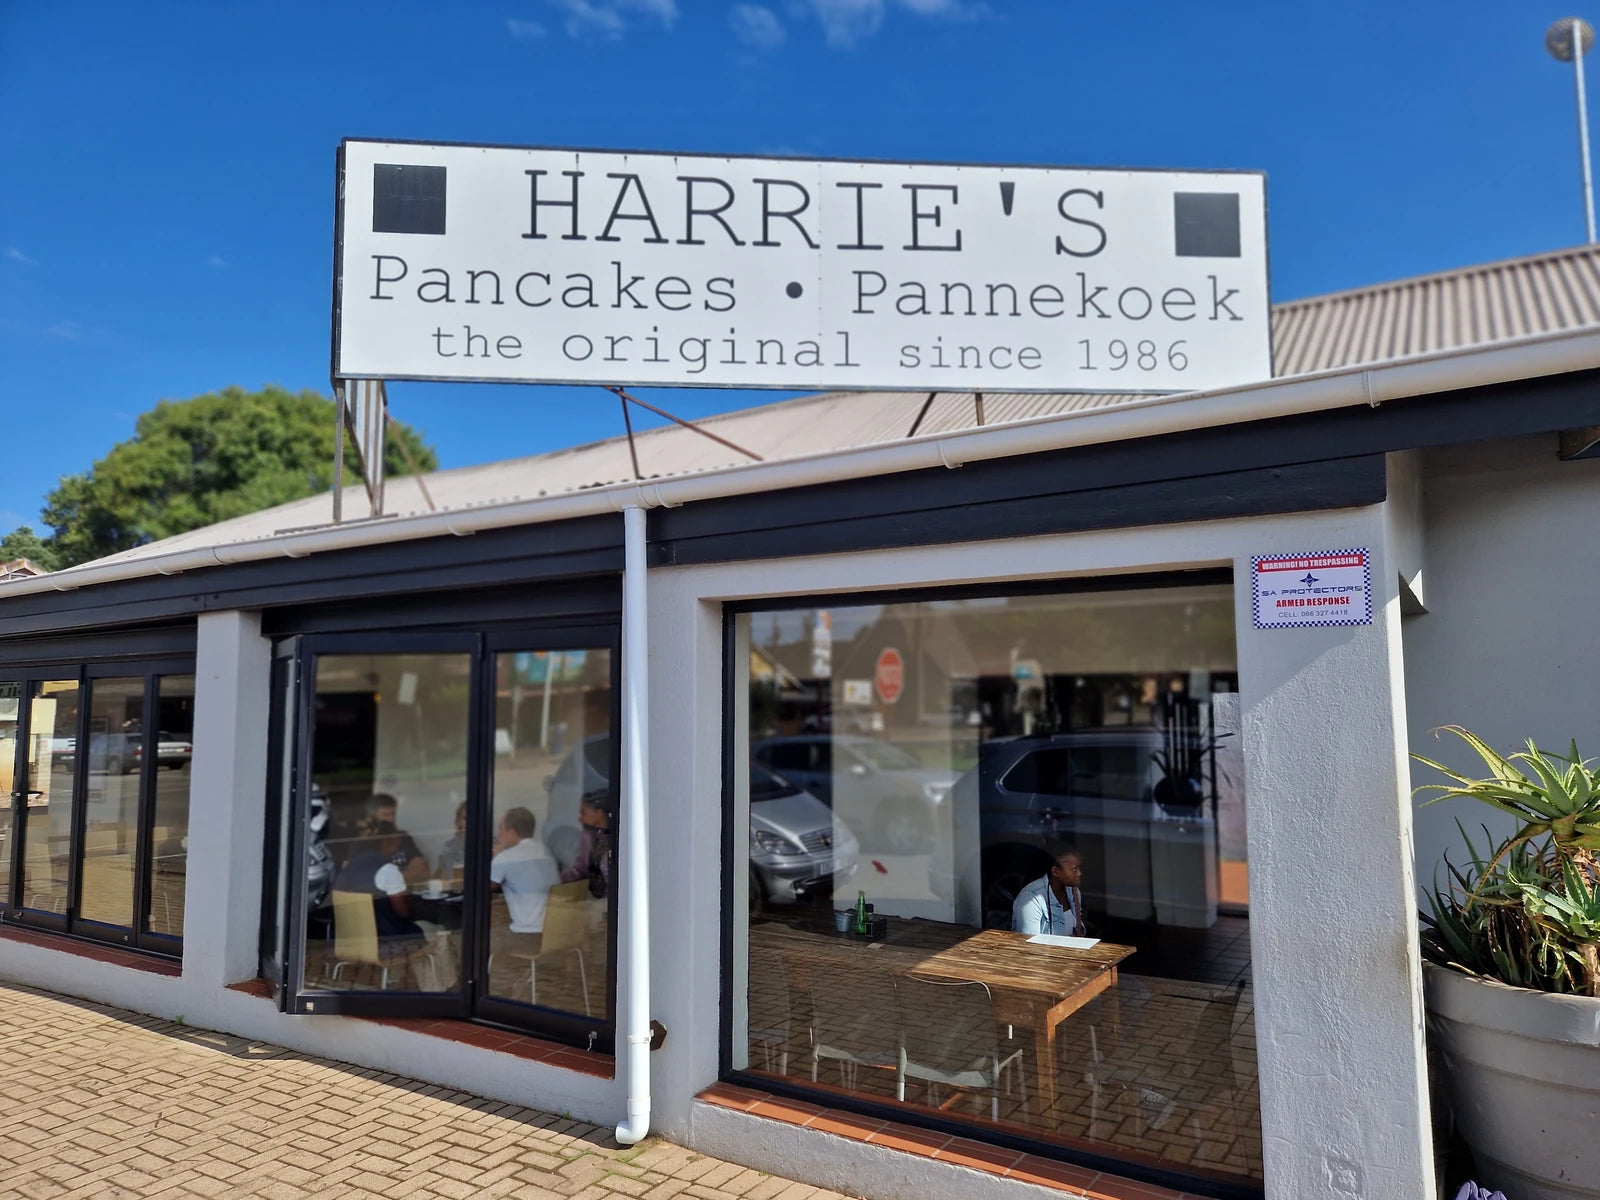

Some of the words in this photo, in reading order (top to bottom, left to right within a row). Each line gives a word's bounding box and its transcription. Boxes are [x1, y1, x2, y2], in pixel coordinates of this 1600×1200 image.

[521, 169, 1106, 258] HARRIE'S
[370, 254, 737, 313] Pancakes
[852, 269, 1244, 322] Pannekoek
[431, 325, 523, 359] the
[562, 326, 860, 374] original
[899, 336, 1043, 370] since
[1078, 338, 1189, 371] 1986
[1262, 560, 1298, 570] WARNING!
[1299, 560, 1309, 568] NO
[1310, 556, 1359, 567] TRESPASSING
[1276, 598, 1305, 608] ARMED
[1307, 596, 1350, 607] RESPONSE
[1281, 585, 1363, 595] PROTECTORS
